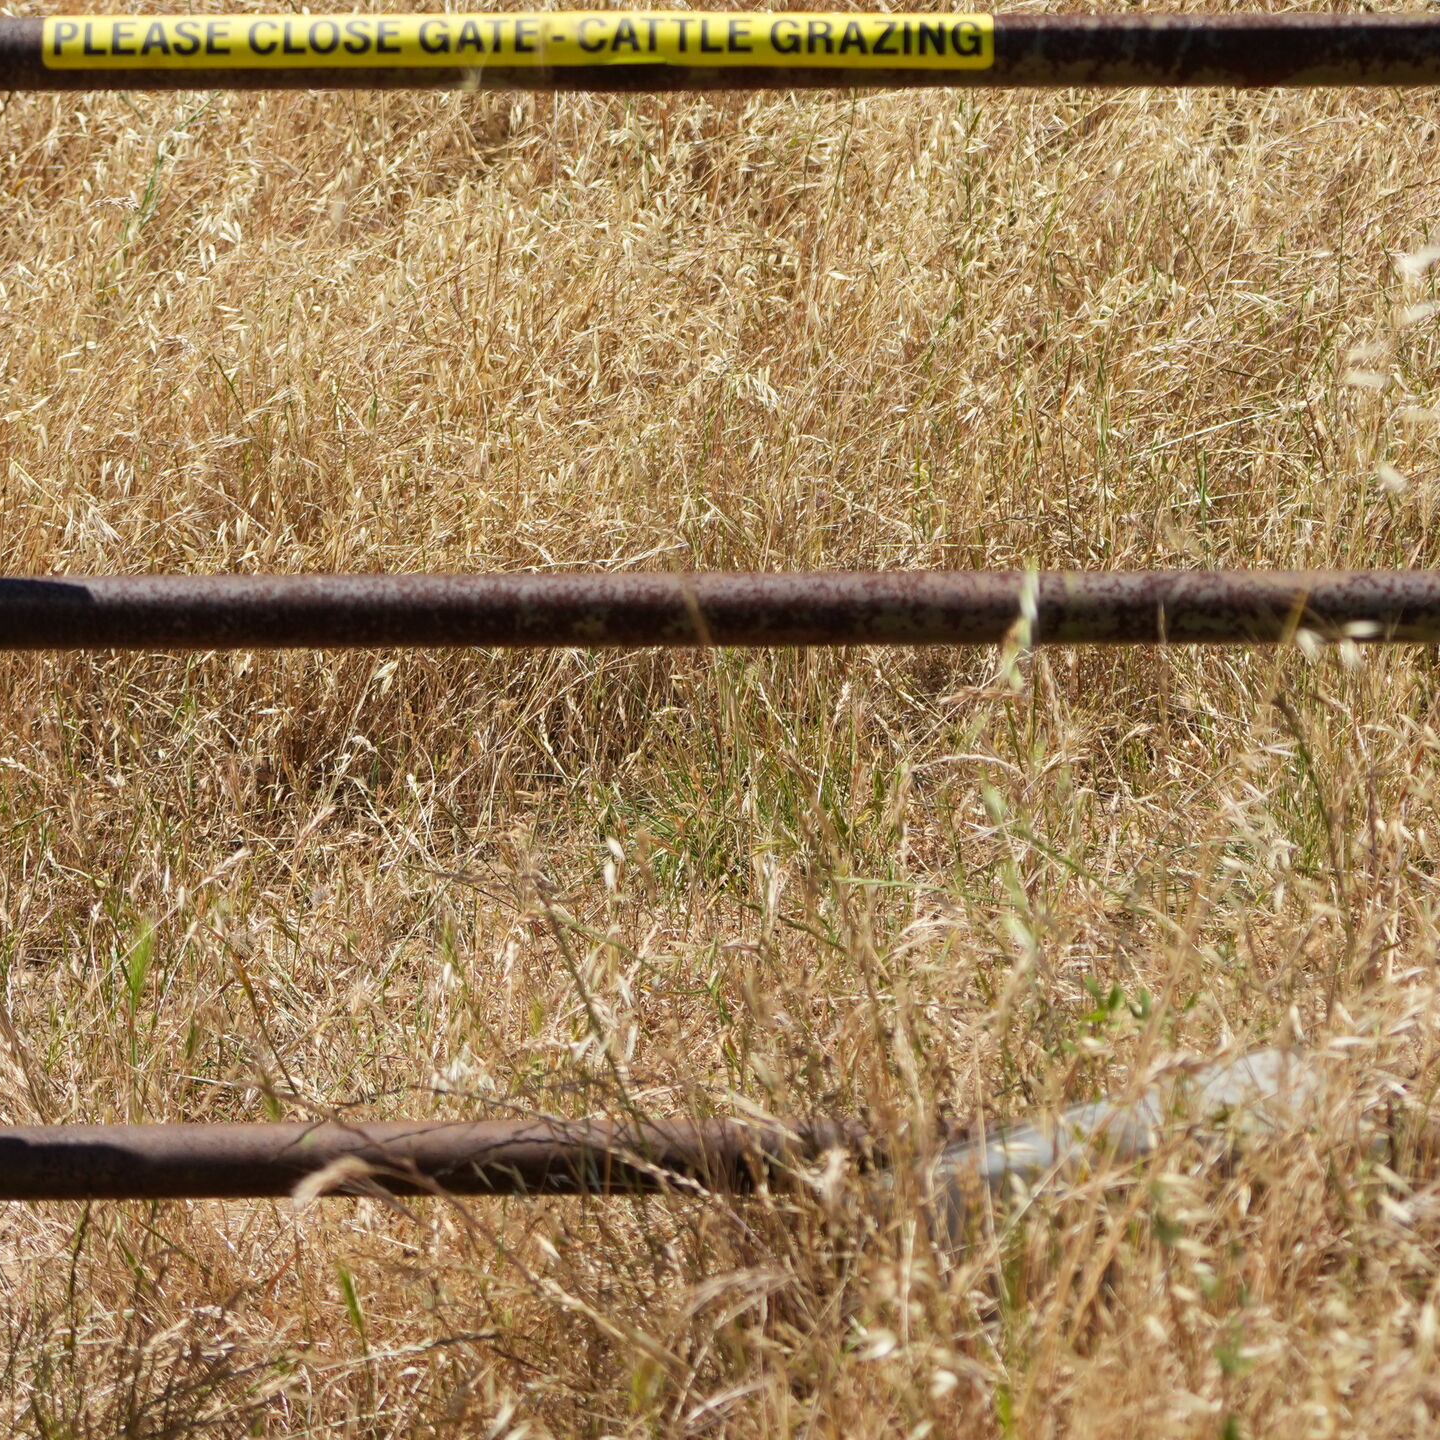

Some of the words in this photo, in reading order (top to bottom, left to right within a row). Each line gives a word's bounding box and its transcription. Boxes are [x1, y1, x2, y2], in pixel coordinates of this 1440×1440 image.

[53, 21, 232, 56] PLEASE
[248, 20, 402, 54] CLOSE
[770, 20, 984, 57] GRAZING
